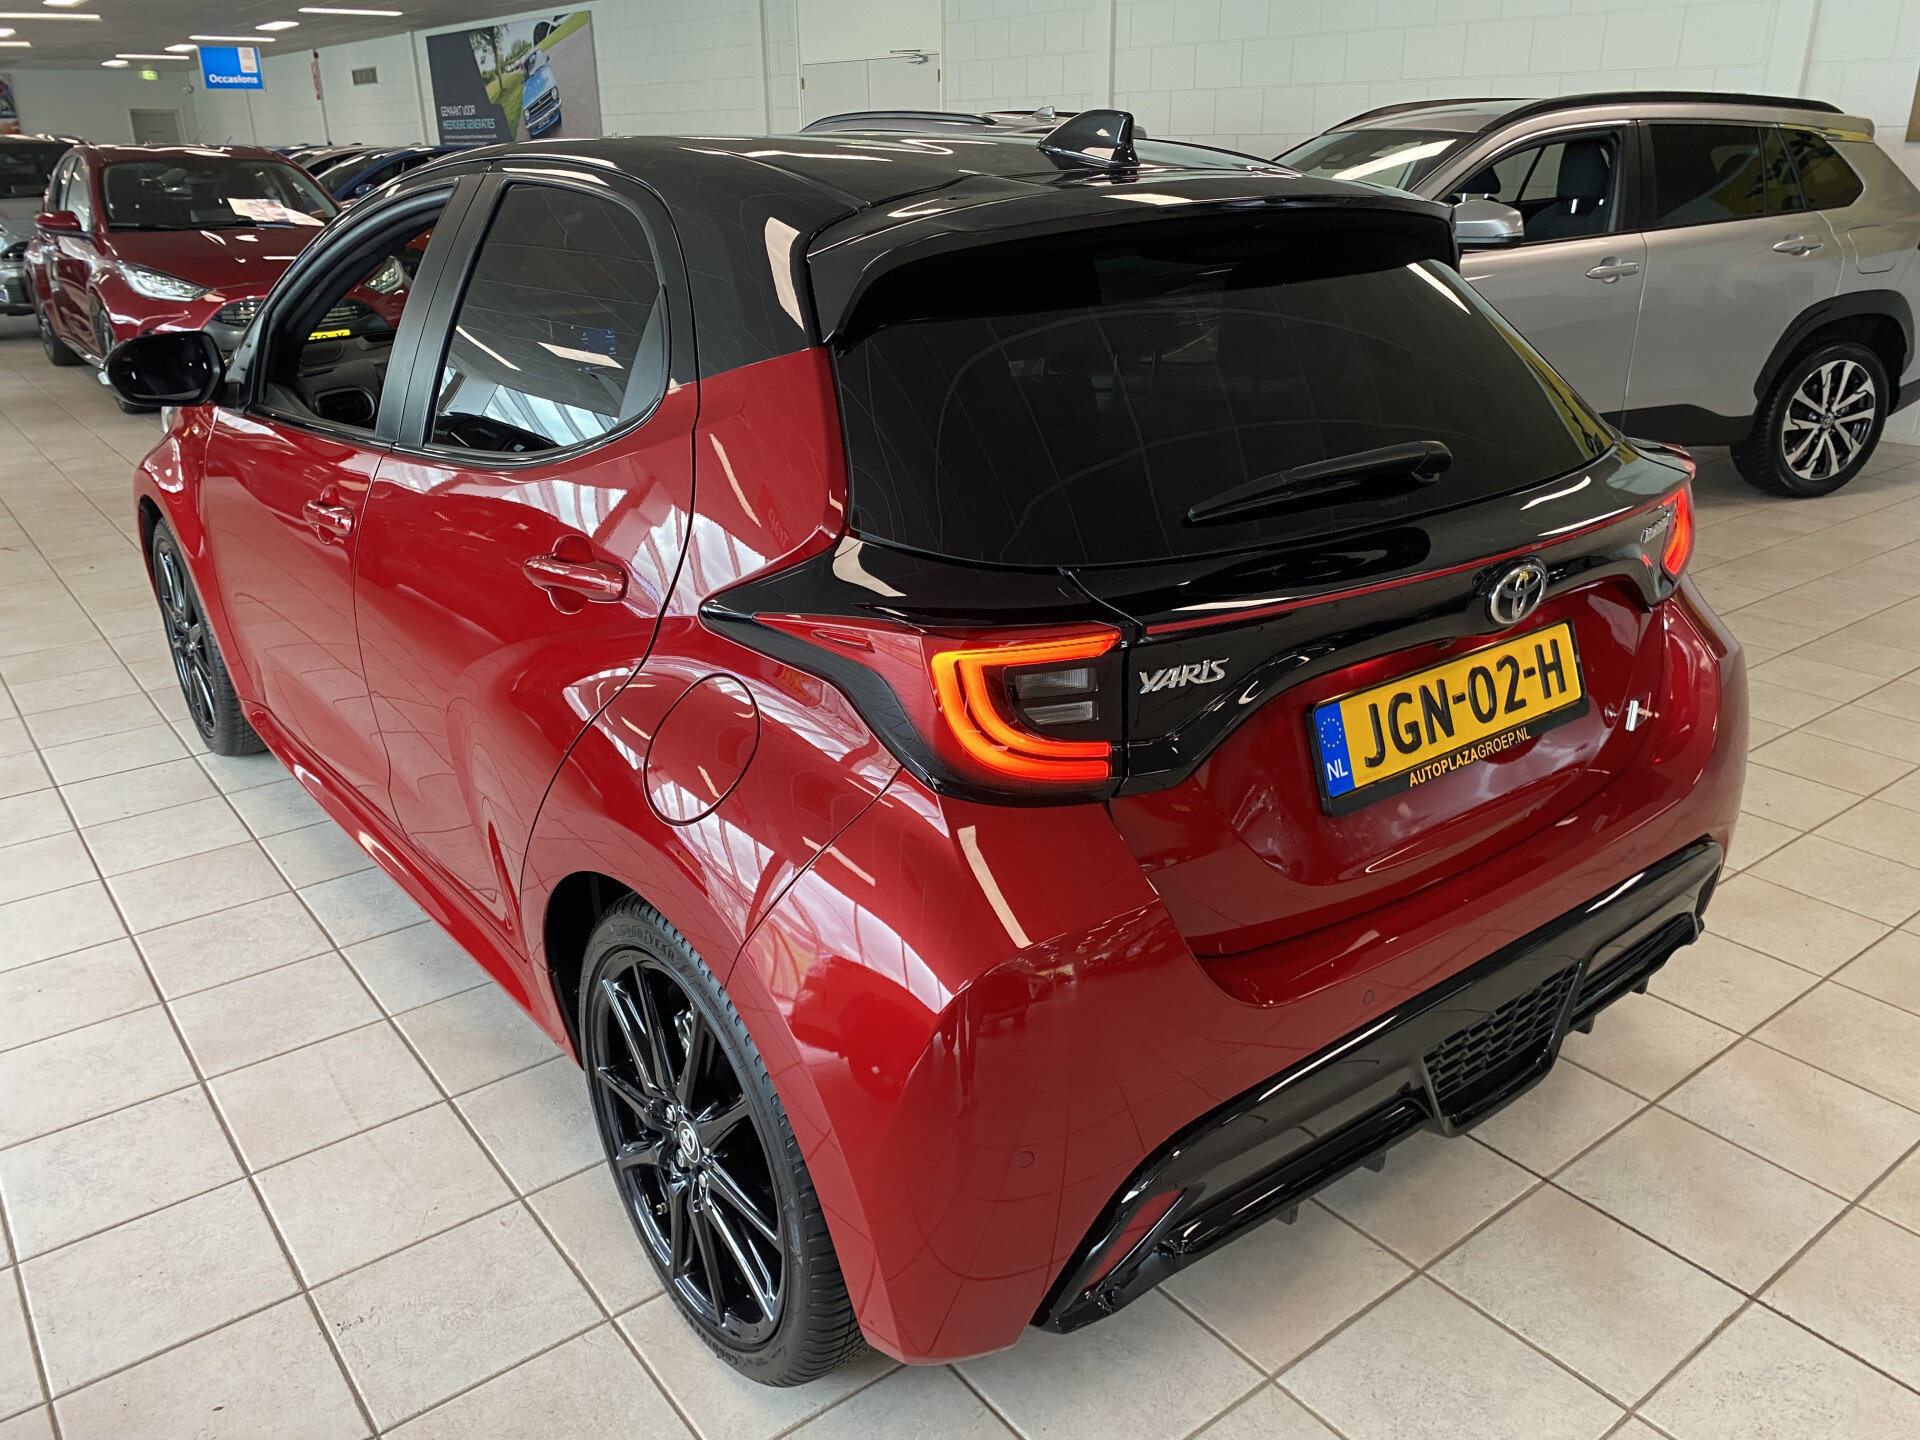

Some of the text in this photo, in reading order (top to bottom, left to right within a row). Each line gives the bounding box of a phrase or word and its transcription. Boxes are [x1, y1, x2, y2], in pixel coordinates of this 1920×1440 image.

[208, 74, 258, 84] Occasions
[1364, 638, 1567, 768] JGN-02-H
[1326, 758, 1349, 782] NL
[1409, 726, 1531, 788] AUTOPLAZAGROEP.NL
